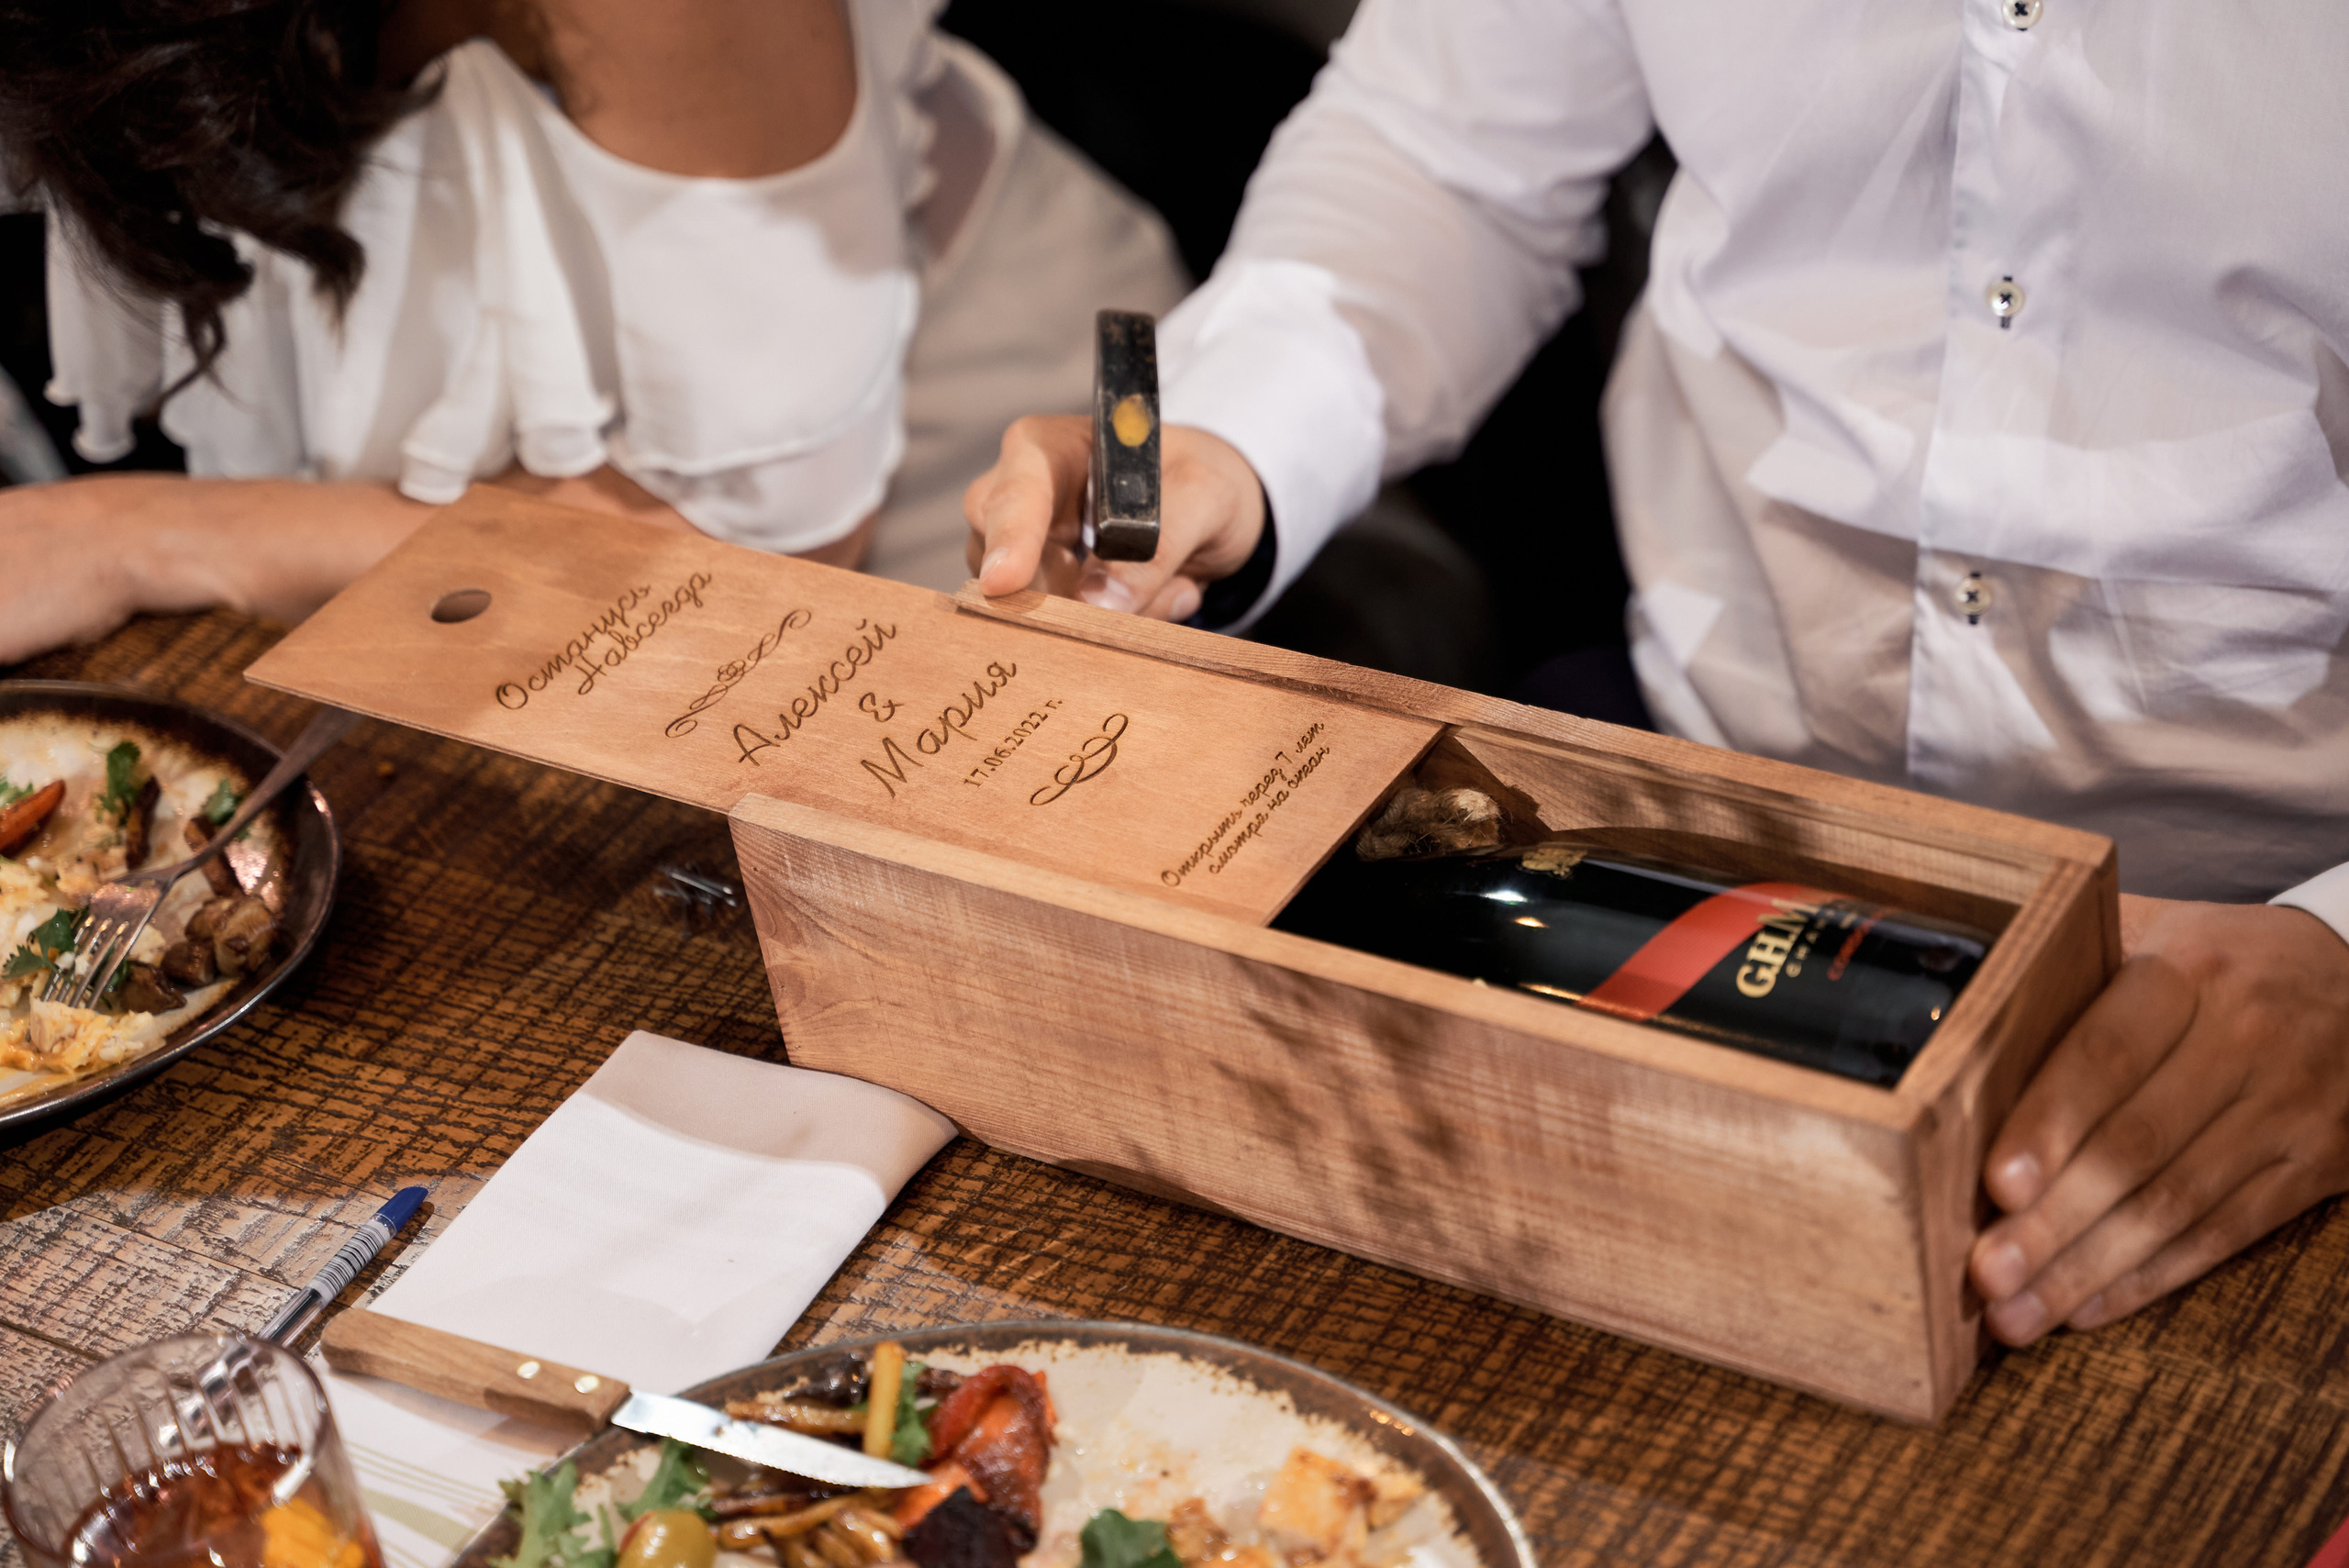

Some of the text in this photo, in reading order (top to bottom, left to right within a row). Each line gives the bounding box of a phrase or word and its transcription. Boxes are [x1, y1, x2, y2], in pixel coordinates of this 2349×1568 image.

[496, 584, 651, 710] Останусь
[574, 573, 712, 695] Навсегда
[733, 618, 896, 767] Алексей
[859, 692, 905, 723] &
[861, 662, 1018, 799] Мария
[963, 711, 1049, 788] 17.06.2022
[1161, 810, 1242, 887] Открыть
[1275, 751, 1293, 764] 7
[1296, 723, 1325, 753] лет
[1208, 747, 1330, 874] смотря на океан
